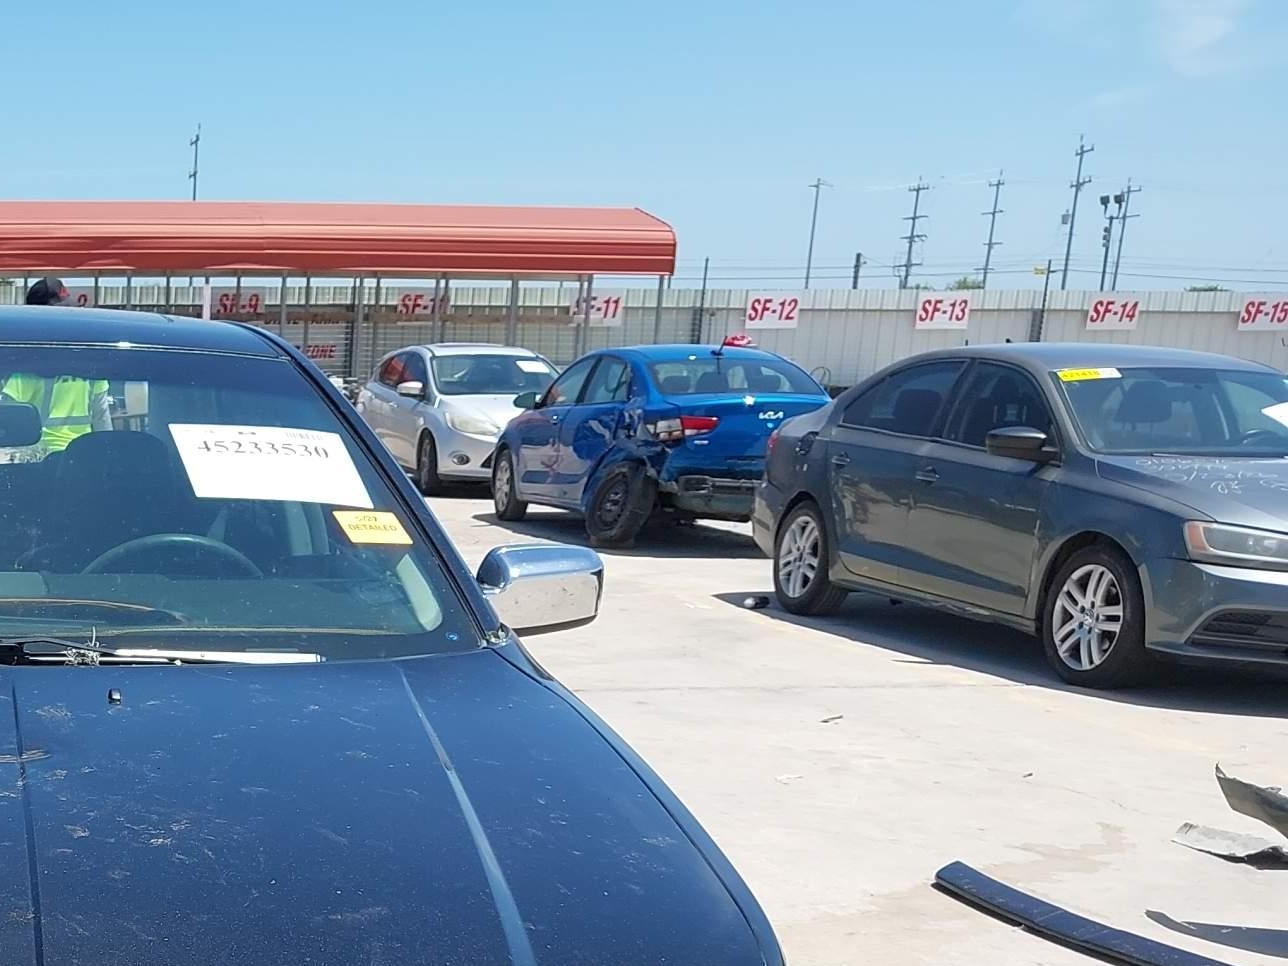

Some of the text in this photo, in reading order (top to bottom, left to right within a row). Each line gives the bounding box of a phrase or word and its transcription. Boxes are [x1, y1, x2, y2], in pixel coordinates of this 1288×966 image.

[748, 298, 799, 321] SF-12
[918, 299, 969, 322] SF-13
[1089, 300, 1139, 323] SF-14
[1240, 301, 1288, 324] SF-15
[197, 440, 330, 459] 45233530
